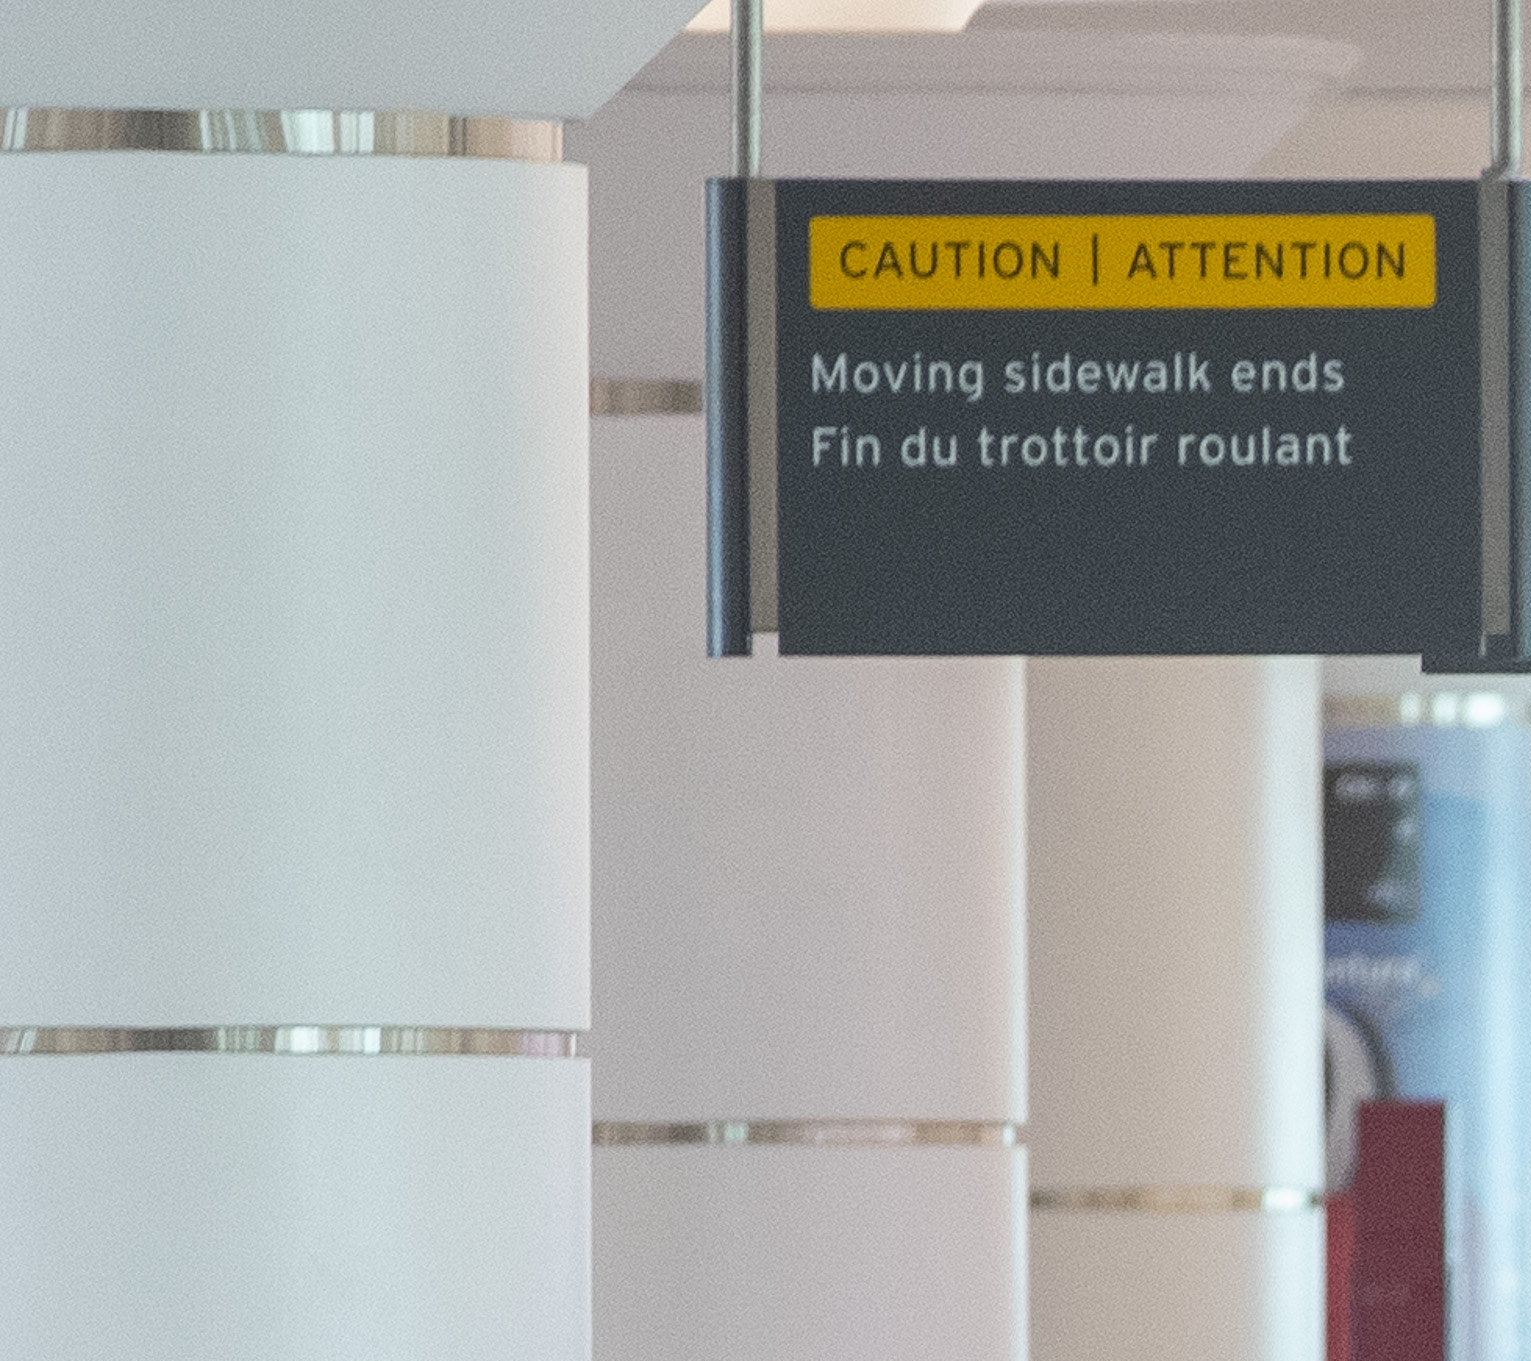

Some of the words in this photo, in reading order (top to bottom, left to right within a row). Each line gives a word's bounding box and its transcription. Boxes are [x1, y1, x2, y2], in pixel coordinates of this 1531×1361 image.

[839, 240, 1062, 282] CAUTION
[1128, 239, 1406, 281] ATTENTION
[811, 353, 985, 402] Moving
[1003, 350, 1206, 394] sidewalk
[1231, 351, 1345, 394] ends
[811, 425, 881, 468] Fin
[902, 425, 959, 467] du
[979, 425, 1159, 467] trottoir
[1178, 423, 1353, 467] roulant
